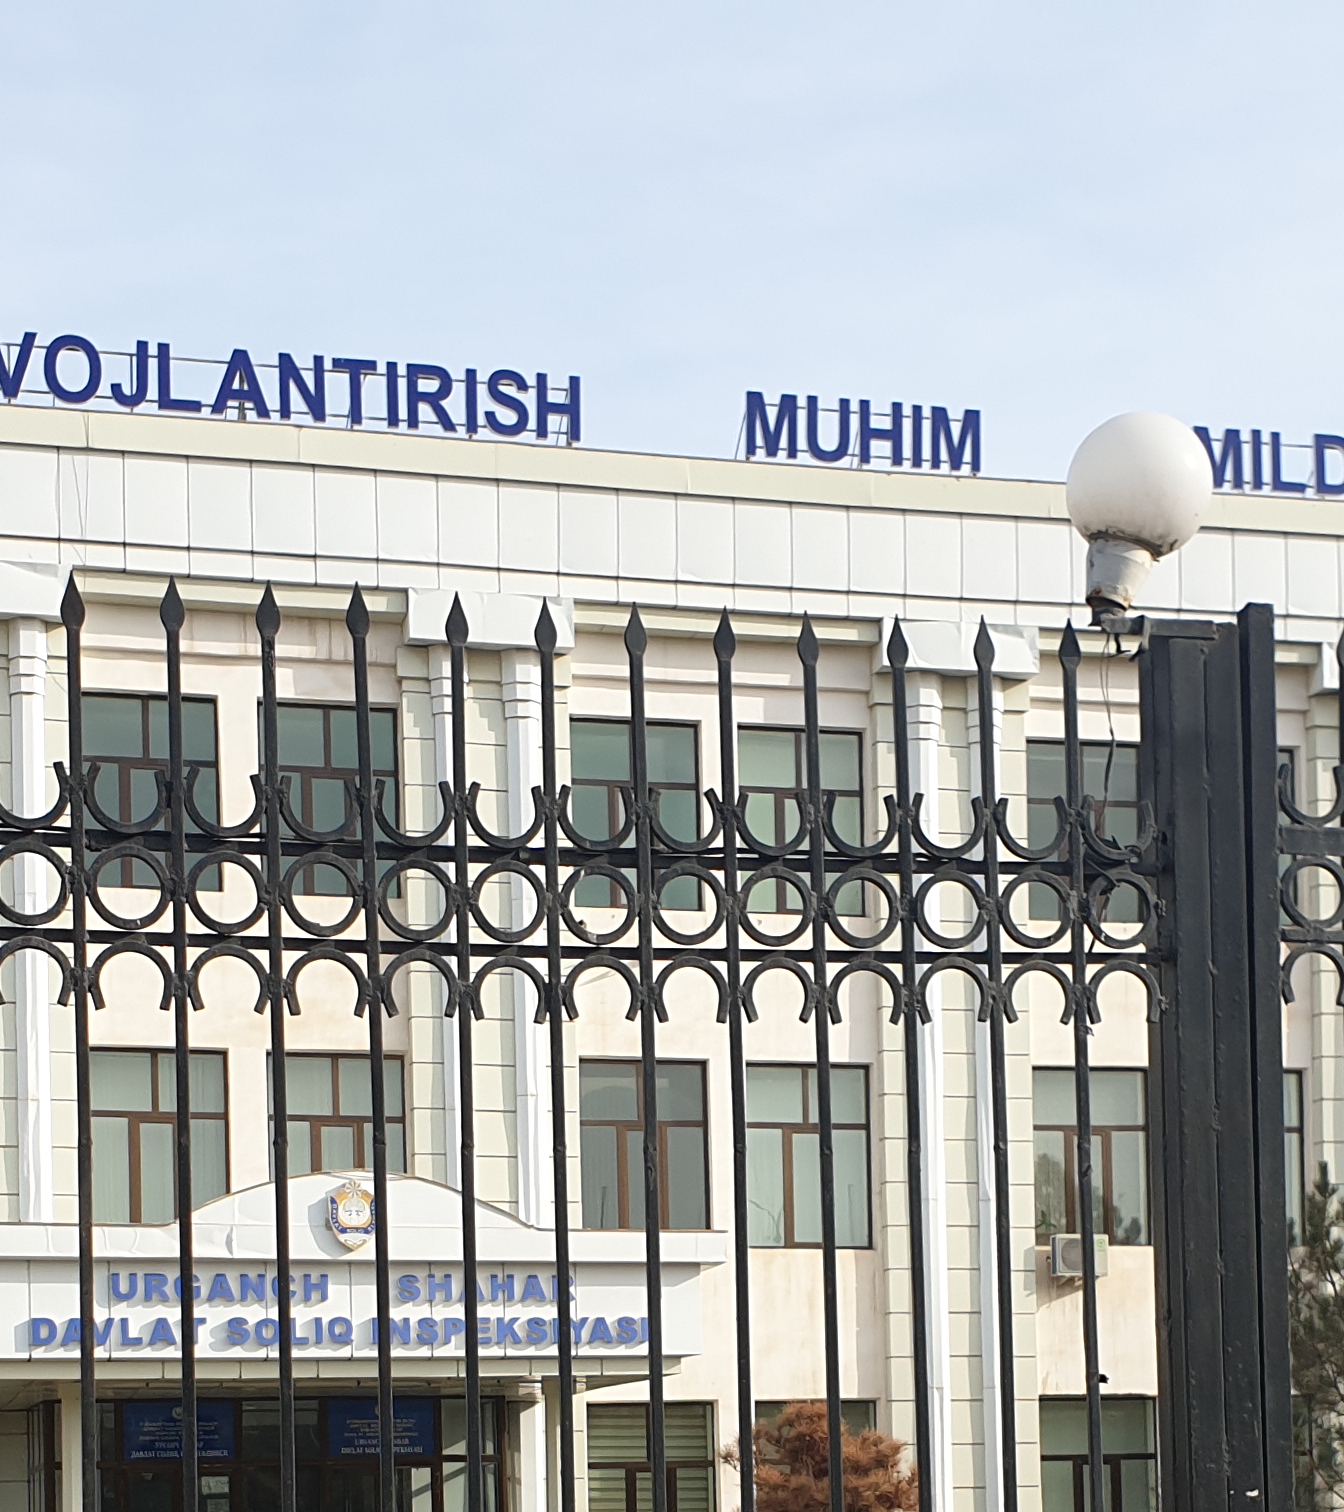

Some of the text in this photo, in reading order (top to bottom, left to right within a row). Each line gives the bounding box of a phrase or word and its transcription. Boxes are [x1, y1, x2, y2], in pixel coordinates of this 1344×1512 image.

[745, 390, 982, 473] MUHIM
[111, 1272, 329, 1301] URGANCH
[32, 1316, 650, 1346] DAVLAT SOLIQ INSPEKSIYASI
